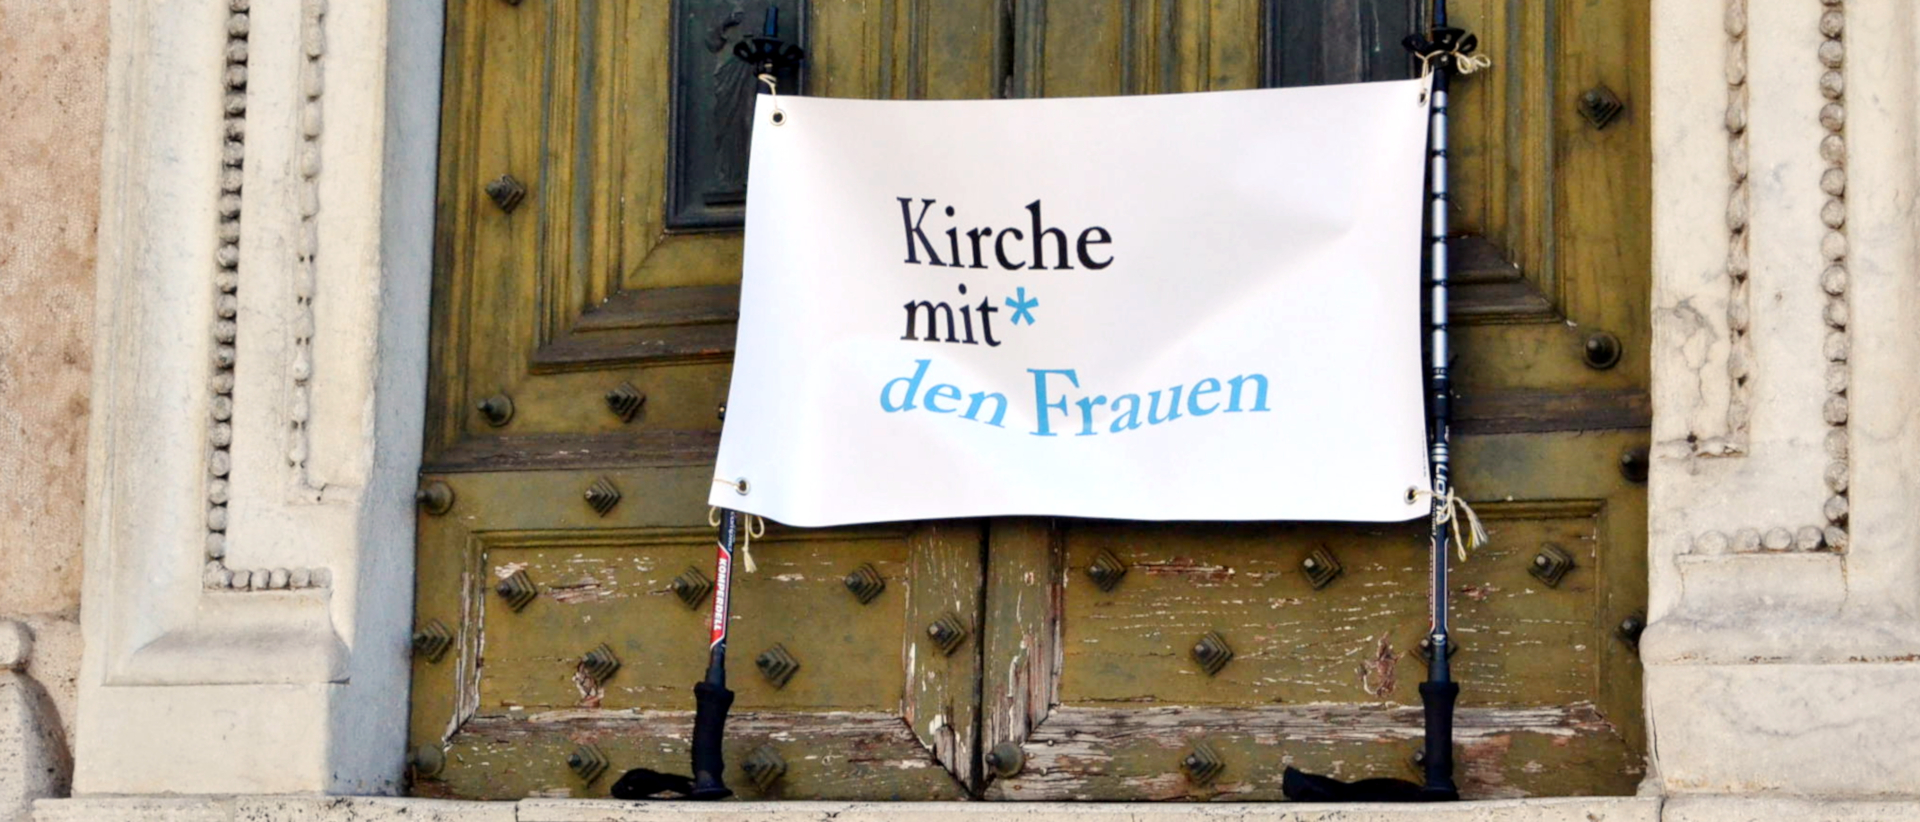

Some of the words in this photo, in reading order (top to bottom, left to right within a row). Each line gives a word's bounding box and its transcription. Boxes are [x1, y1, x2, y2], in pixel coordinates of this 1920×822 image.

[896, 196, 1115, 271] Kirche
[879, 359, 1008, 428] den
[1026, 368, 1271, 437] Frauen
[713, 557, 728, 631] KOMPERDELL
